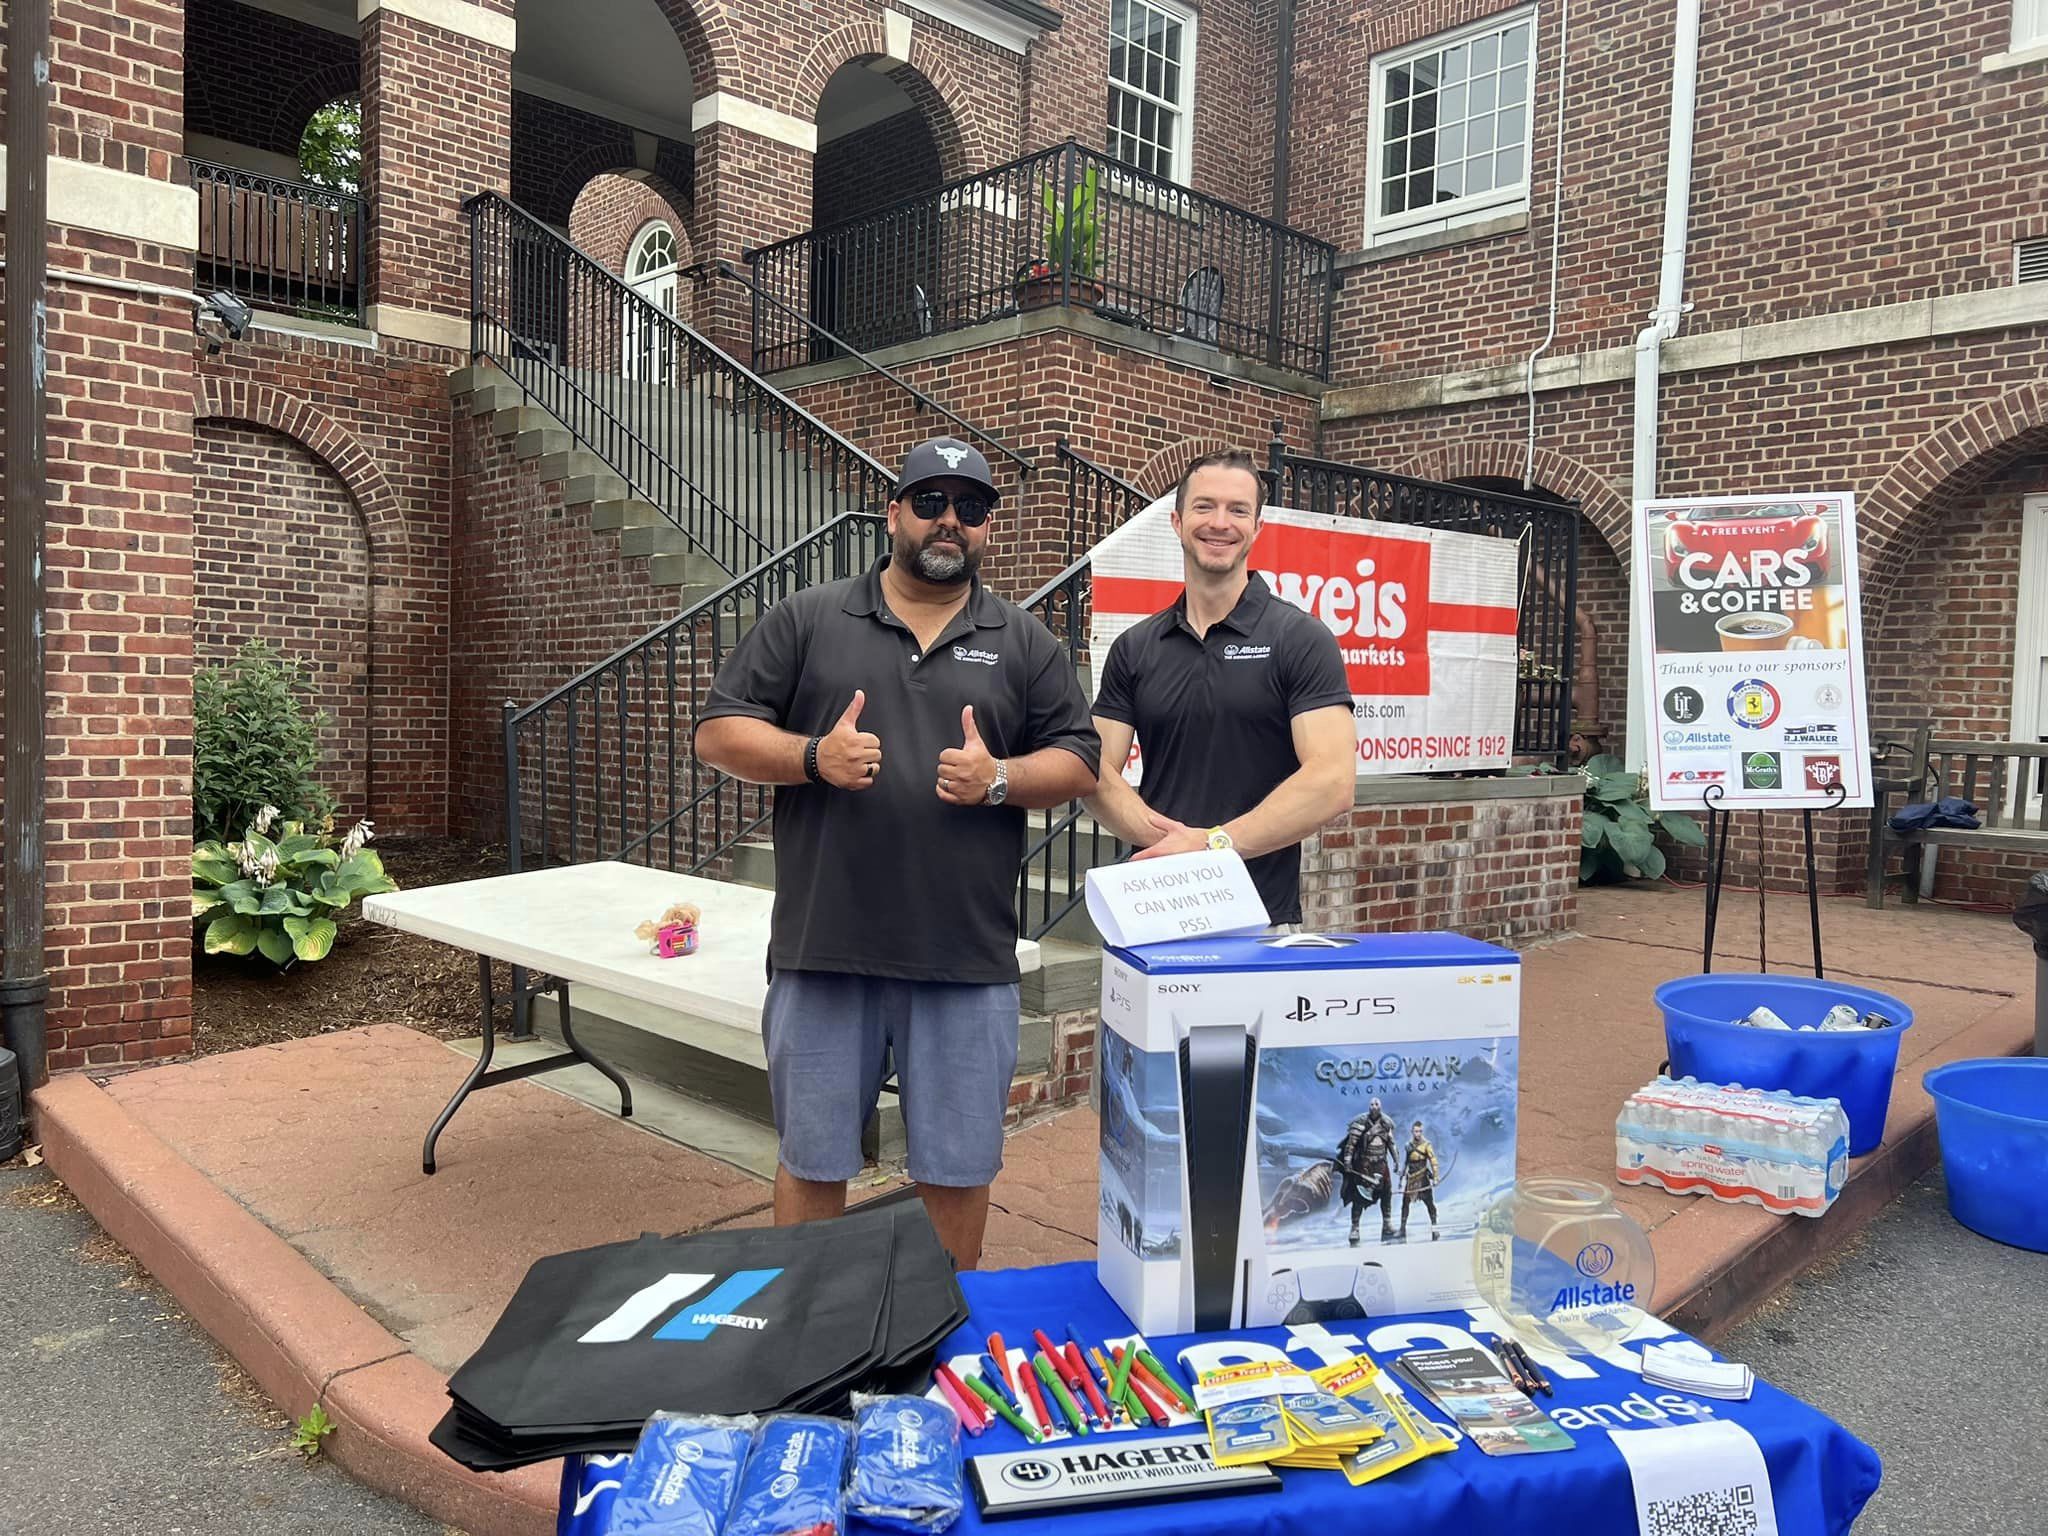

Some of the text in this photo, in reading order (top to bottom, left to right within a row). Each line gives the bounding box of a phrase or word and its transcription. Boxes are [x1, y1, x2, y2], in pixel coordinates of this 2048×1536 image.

[1701, 525, 1776, 537] A FREE EVENT
[1679, 549, 1811, 590] CARS
[1238, 645, 1271, 655] Allstate
[1660, 660, 1847, 677] Thank you to our sponsors!
[1425, 735, 1471, 759] SINCE
[1477, 735, 1506, 756] 1912
[1685, 732, 1732, 743] Allstate
[1123, 865, 1224, 895] ASK HOW YOU
[1134, 888, 1235, 915] CAN WIN THIS
[1179, 917, 1213, 933] PS5!
[1158, 984, 1200, 994] SONY
[1325, 997, 1395, 1017] PS5
[1314, 1058, 1377, 1088] GOD
[1402, 1055, 1462, 1082] WAR
[1681, 1159, 1714, 1173] spring
[1714, 1167, 1745, 1177] water
[1550, 1280, 1635, 1312] Allstate
[691, 1313, 768, 1330] HAGERTY
[1551, 1392, 1714, 1433] ands.
[1061, 1442, 1212, 1474] HAGERT
[1070, 1474, 1096, 1486] FOR
[1098, 1468, 1144, 1484] PEOPLE
[1144, 1465, 1175, 1479] WHO
[1175, 1463, 1204, 1475] LOVE
